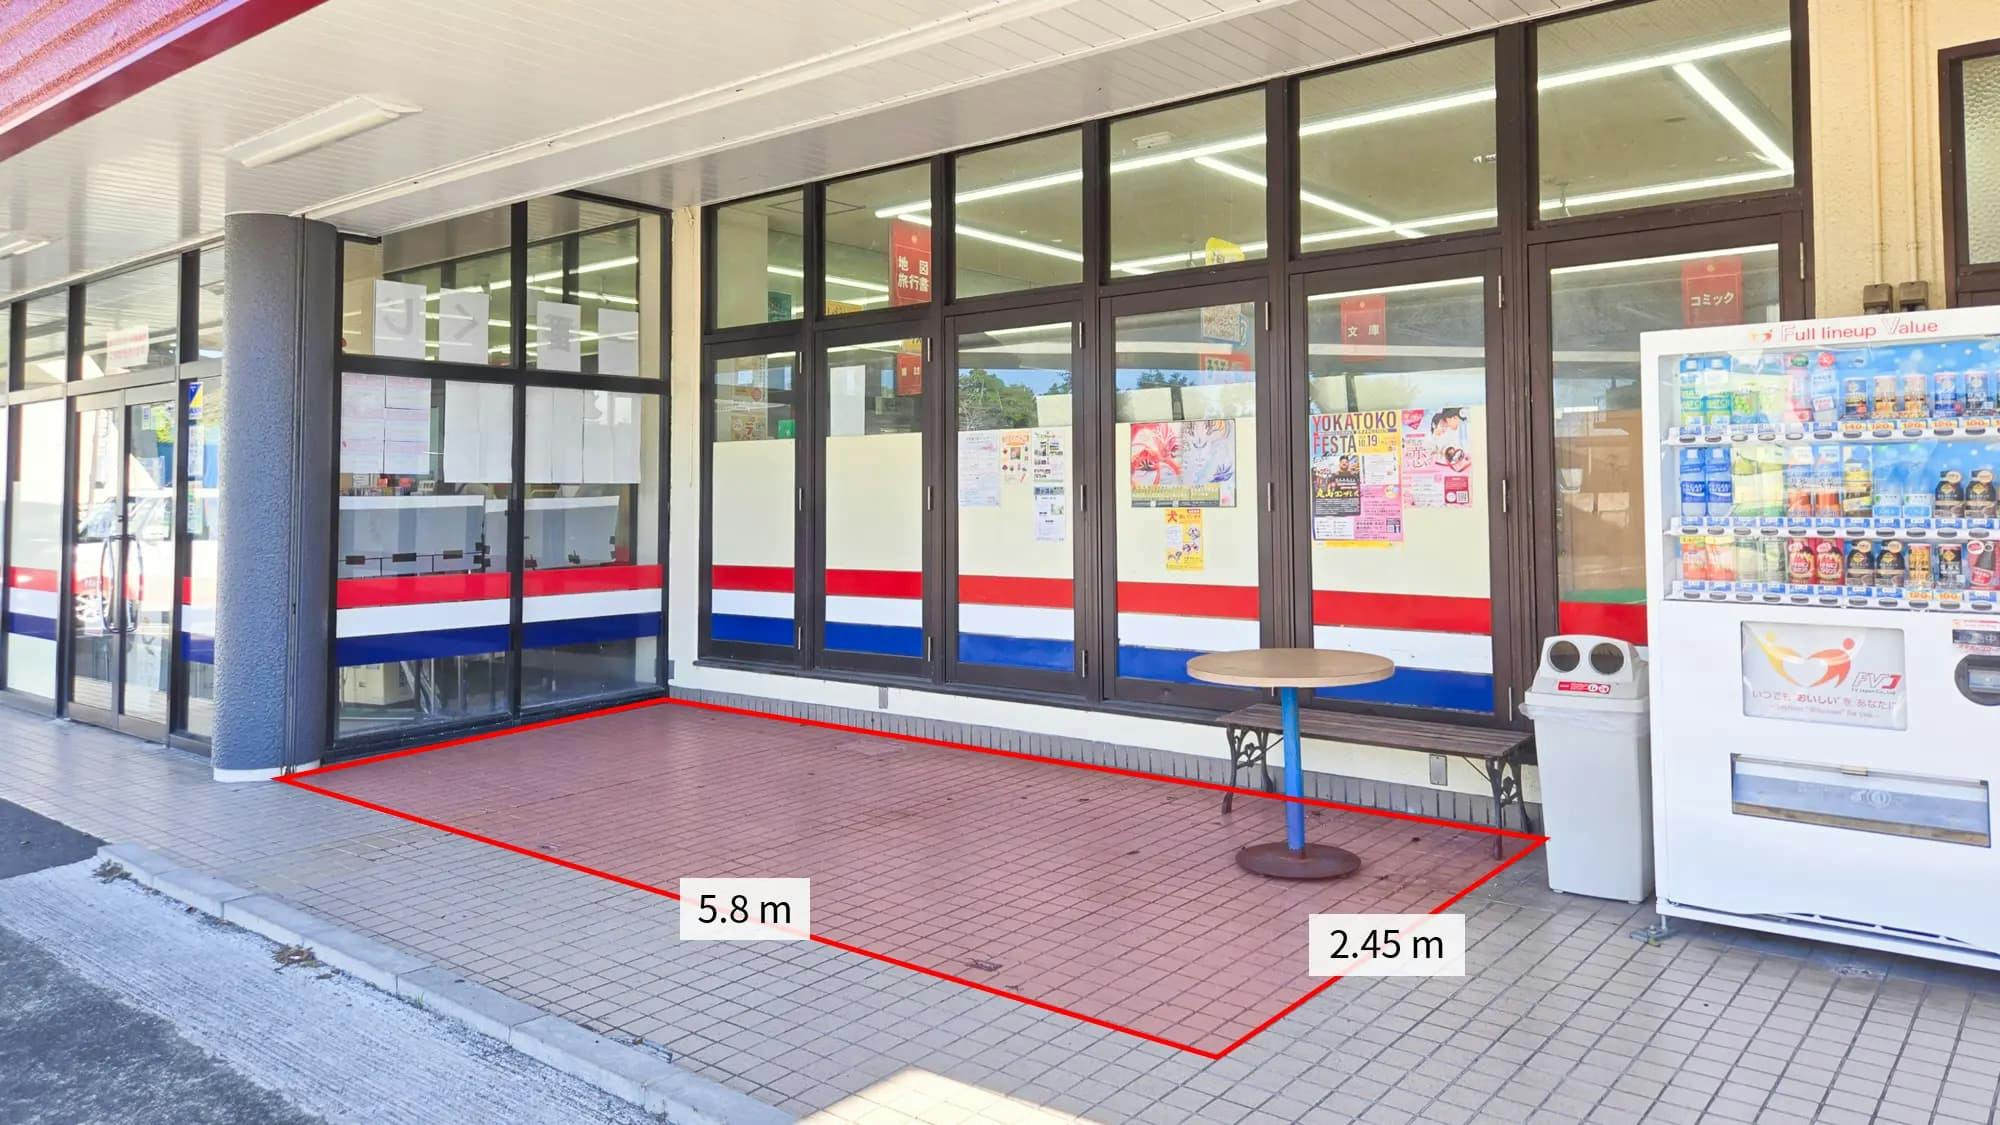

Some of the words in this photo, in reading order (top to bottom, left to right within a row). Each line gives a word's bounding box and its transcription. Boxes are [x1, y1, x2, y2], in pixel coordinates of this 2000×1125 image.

[898, 255, 929, 275] 地図
[897, 273, 929, 292] 旅行書
[1690, 291, 1735, 307] コミック
[1347, 324, 1380, 337] 文庫
[1781, 325, 1816, 343] Full
[1821, 323, 1877, 342] lineup
[1881, 317, 1939, 336] Value
[1312, 411, 1397, 432] YOKATOKO
[1313, 432, 1357, 455] FESTA
